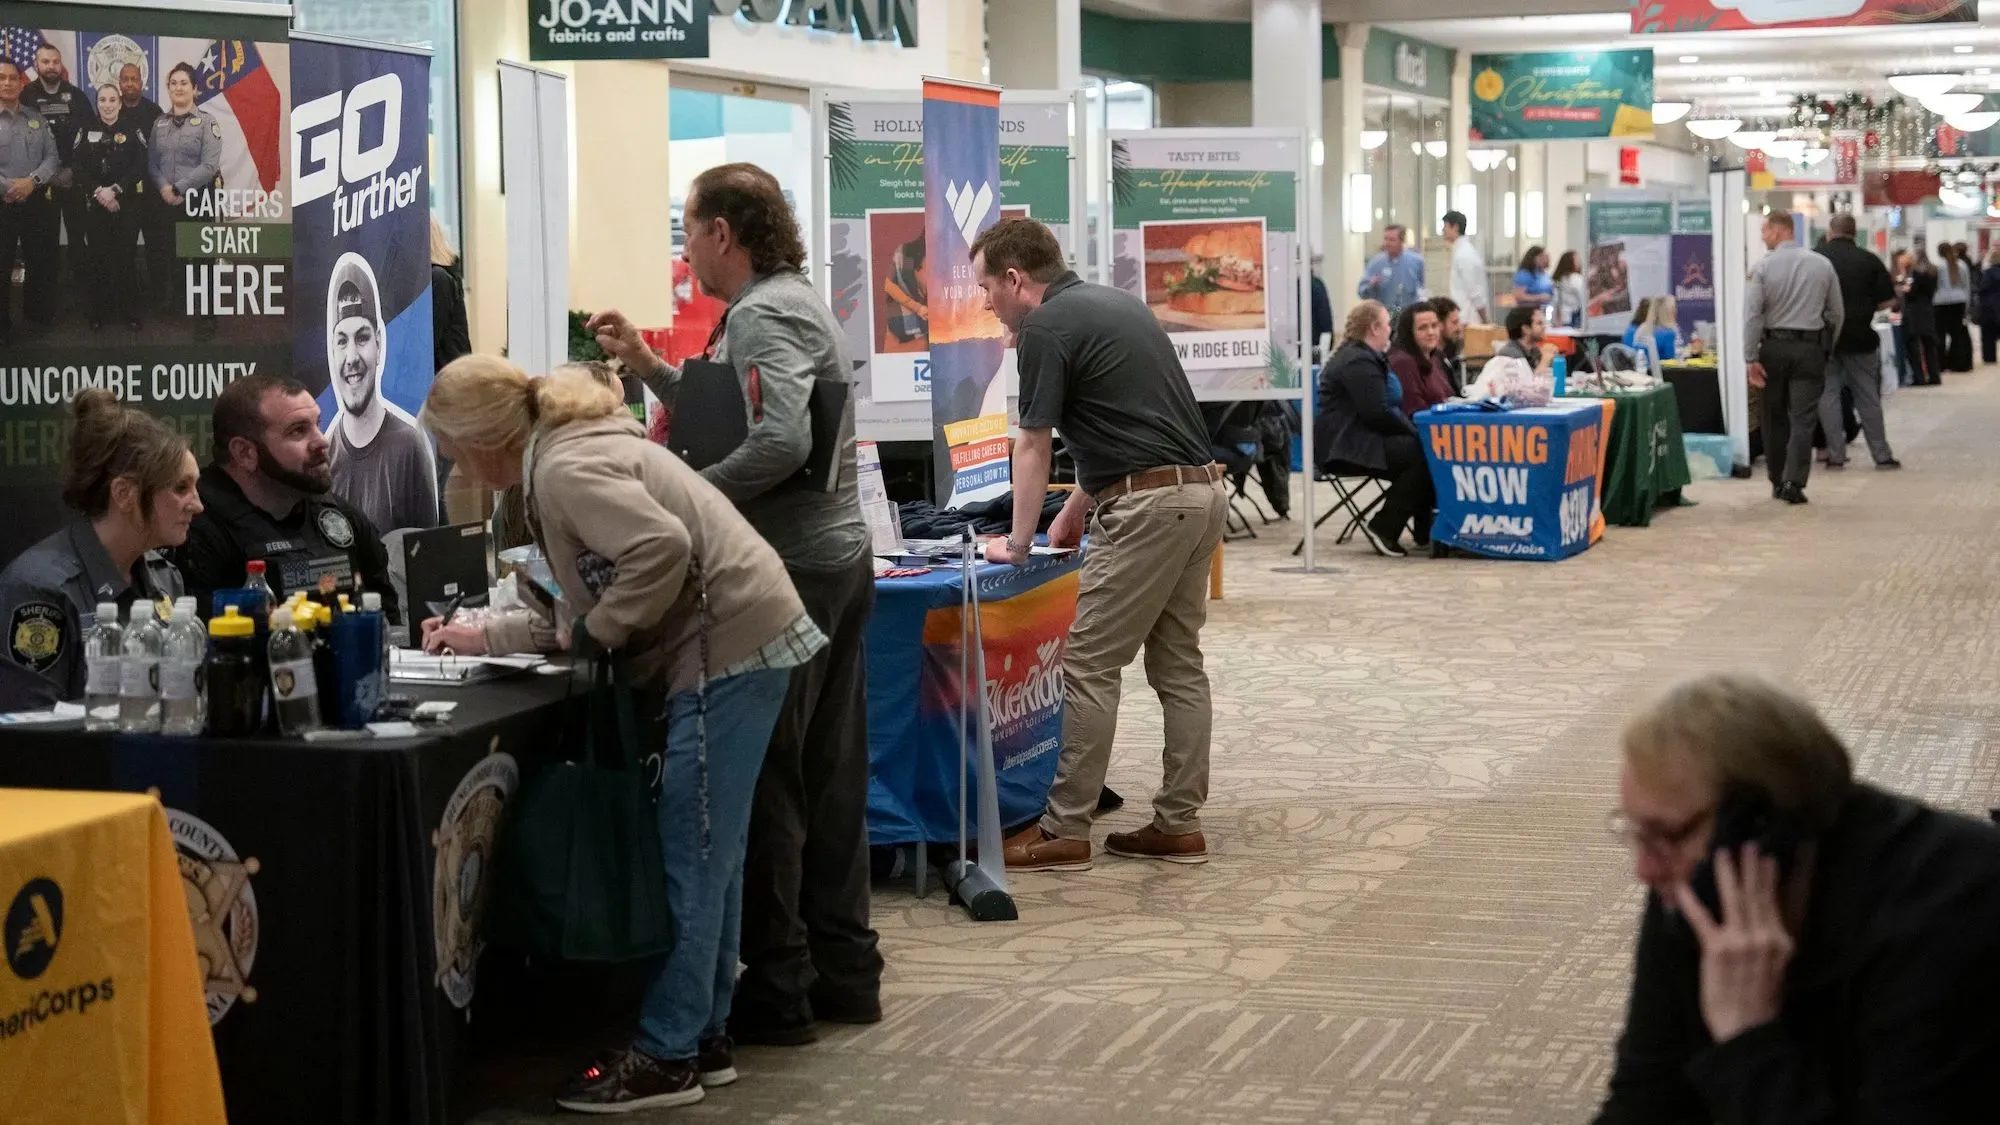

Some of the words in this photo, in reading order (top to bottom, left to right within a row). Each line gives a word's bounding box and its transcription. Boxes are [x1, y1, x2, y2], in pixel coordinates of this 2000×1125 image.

[549, 28, 601, 43] fabrics
[605, 27, 635, 42] and
[641, 26, 686, 41] crafts
[999, 121, 1025, 133] NDS
[292, 73, 402, 207] GO
[864, 154, 889, 166] in
[1168, 151, 1205, 162] TASTY
[1208, 151, 1240, 161] BITES
[879, 178, 903, 189] Sleigh
[905, 178, 917, 188] the
[894, 190, 912, 199] looks
[185, 187, 283, 218] CAREERS
[333, 165, 422, 237] further
[200, 227, 261, 255] START
[952, 264, 976, 279] ELEV
[185, 264, 285, 316] HERE
[1193, 341, 1229, 359] RIDGE
[1233, 340, 1259, 357] DELI
[0, 364, 142, 405] UNCOMBE
[151, 361, 257, 400] COUNTY
[914, 385, 932, 393] DRE
[981, 442, 1007, 458] CAREERS
[1430, 424, 1548, 465] HIRING
[955, 472, 983, 491] PERSONAL
[984, 466, 1008, 482] GROWTH
[1452, 465, 1528, 505] NOW
[1460, 514, 1533, 536] MAU
[986, 650, 1064, 730] BlueRidg
